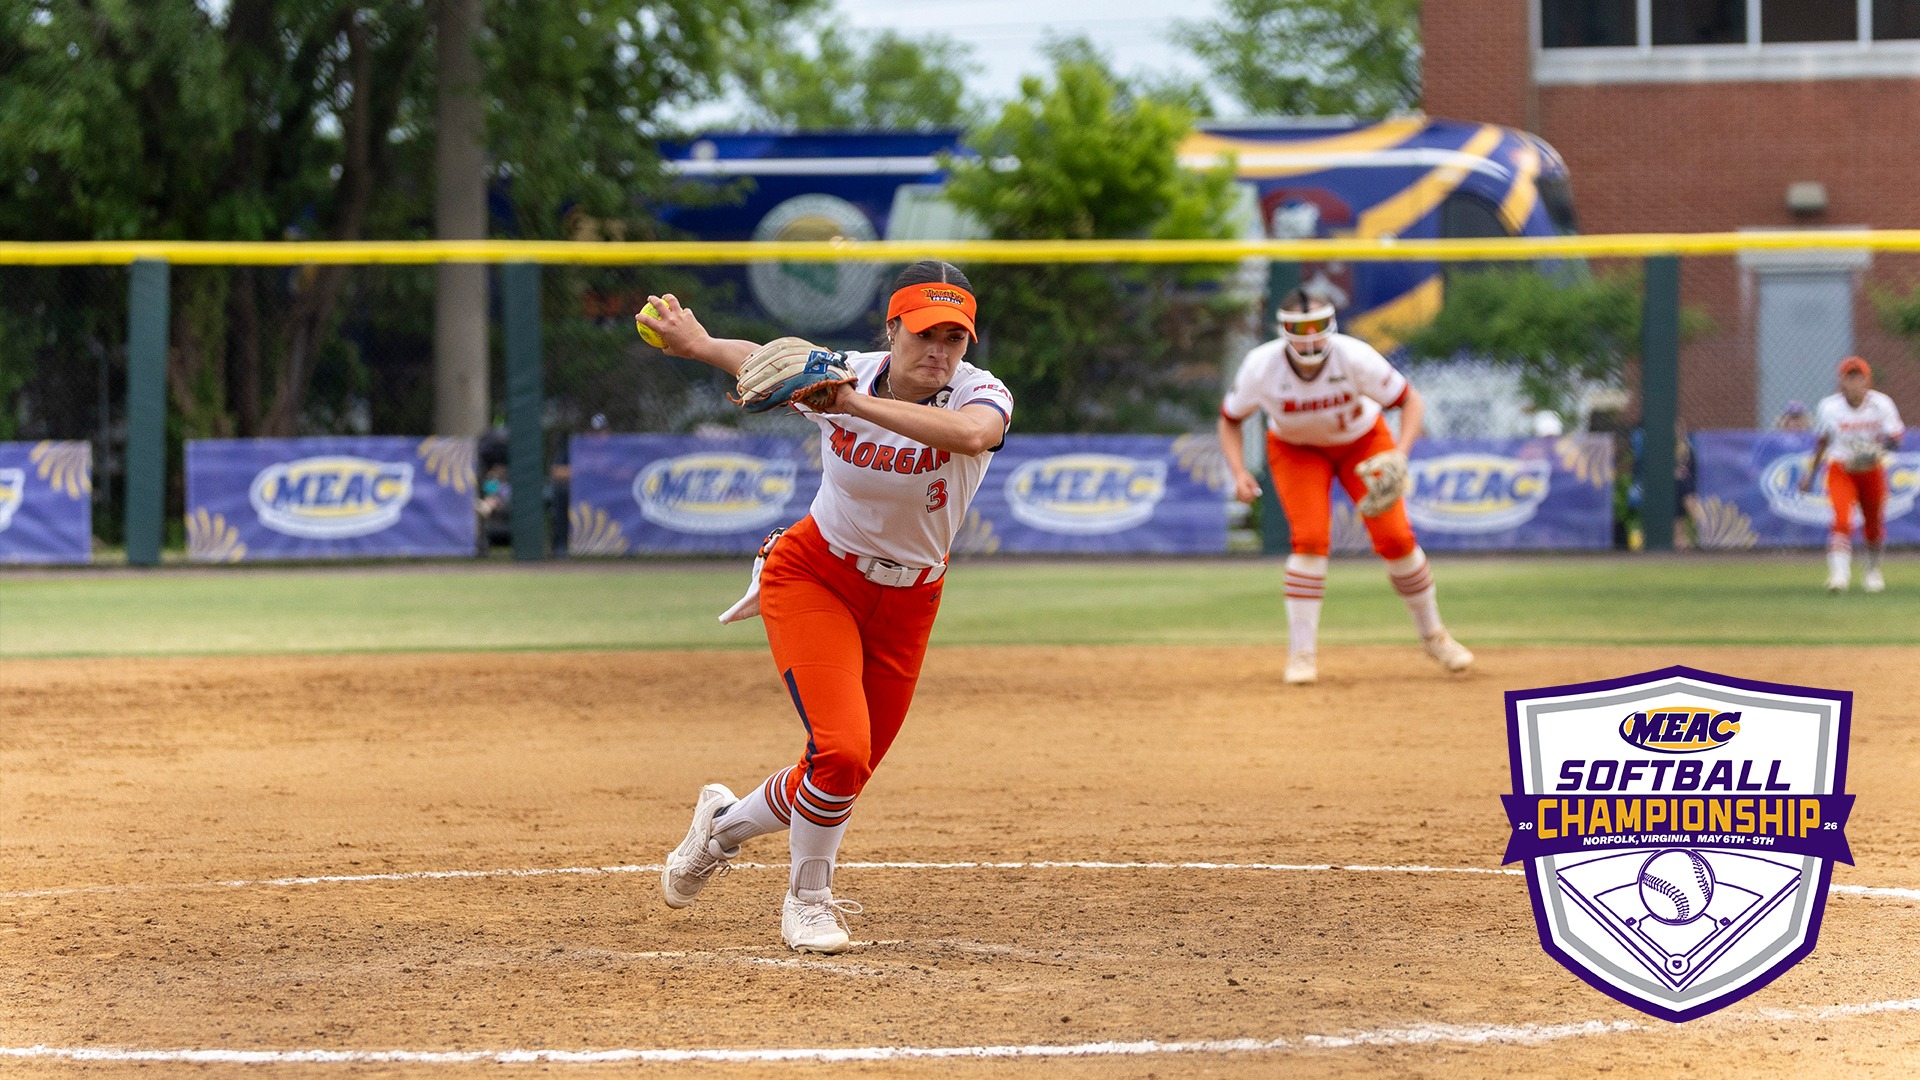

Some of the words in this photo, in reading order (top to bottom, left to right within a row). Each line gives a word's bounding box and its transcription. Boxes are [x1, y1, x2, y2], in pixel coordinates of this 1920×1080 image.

[271, 472, 405, 509] MEAC
[651, 467, 793, 505] MEAC
[926, 478, 948, 513] 3
[1020, 468, 1156, 505] MEAC
[1411, 469, 1543, 504] MEAC
